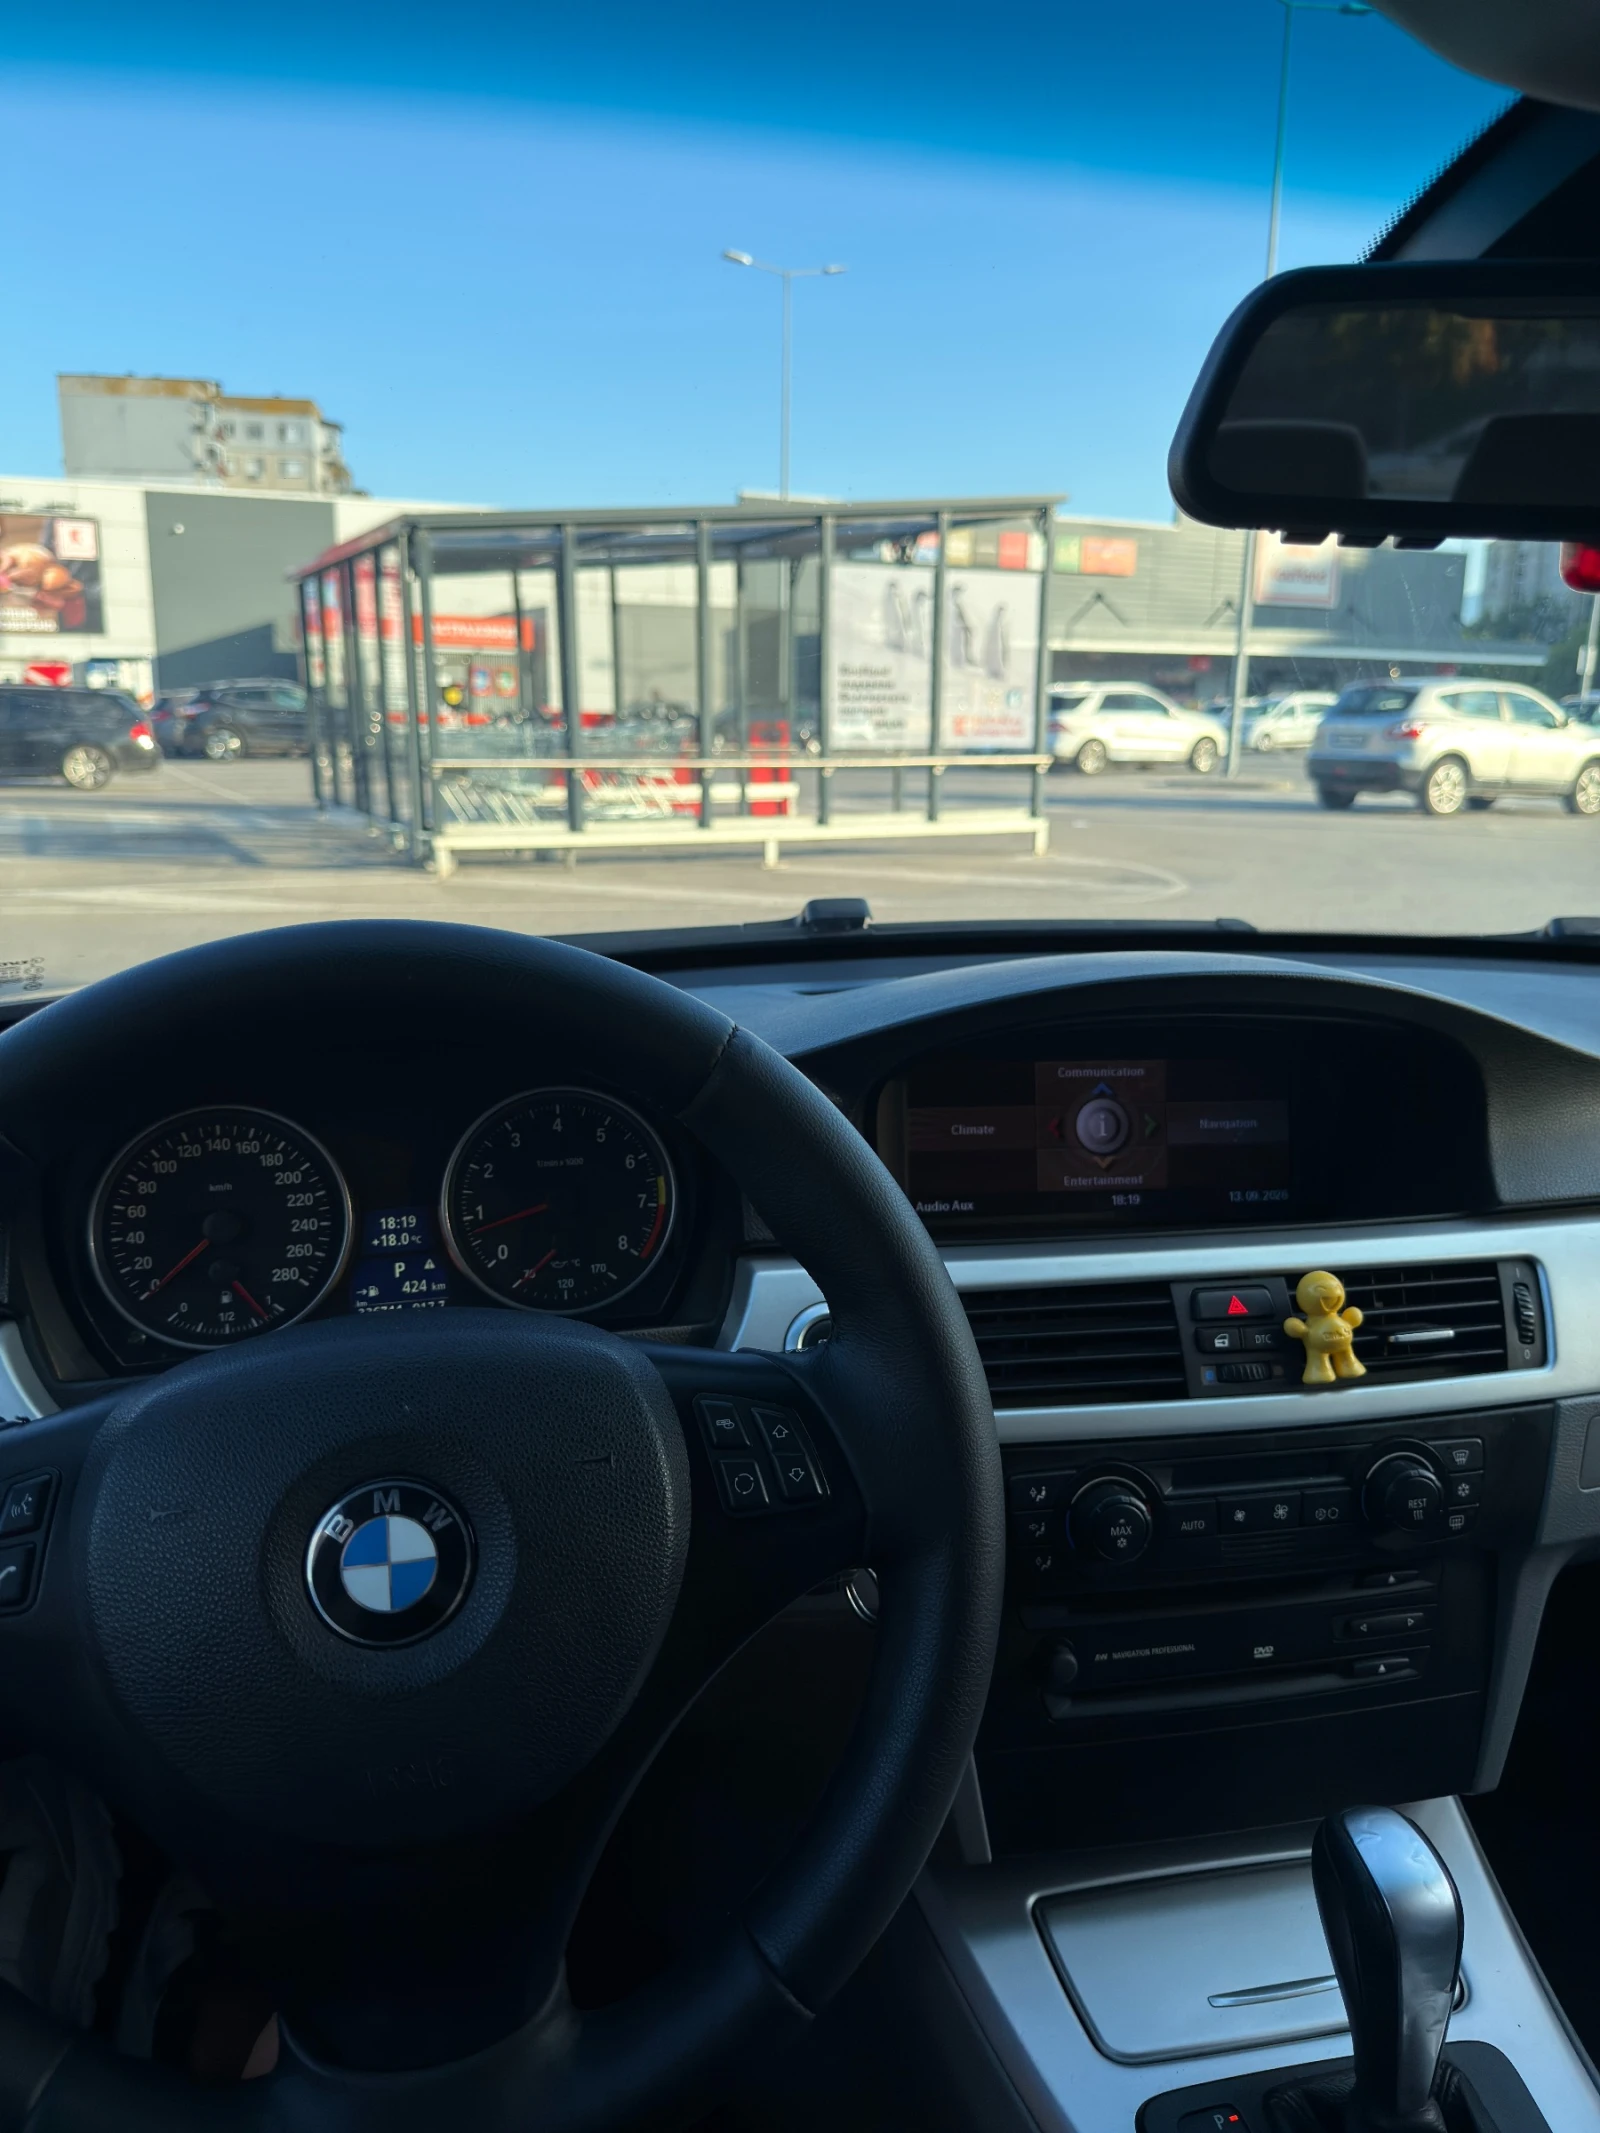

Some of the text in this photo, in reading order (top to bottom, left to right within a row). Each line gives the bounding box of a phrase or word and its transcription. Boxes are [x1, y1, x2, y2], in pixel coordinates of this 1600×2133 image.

[1057, 1067, 1145, 1078] Communication
[552, 1117, 564, 1133] 4
[950, 1124, 995, 1136] Climate
[1199, 1119, 1258, 1131] Navigation
[510, 1132, 521, 1148] 3
[596, 1127, 606, 1143] 5
[177, 1143, 202, 1158] 120
[205, 1137, 231, 1152] 140
[235, 1140, 260, 1155] 160
[151, 1160, 178, 1174] 100
[259, 1153, 284, 1167] 180
[625, 1154, 636, 1169] 6
[483, 1163, 494, 1178] 2
[274, 1171, 302, 1186] 200
[1063, 1174, 1144, 1187] Entertainment
[137, 1181, 157, 1195] 80
[208, 1182, 233, 1192] km/h
[286, 1192, 314, 1208] 220
[637, 1193, 648, 1209] 7
[915, 1199, 974, 1213] Audio Aux
[1111, 1193, 1141, 1206] 18:19
[127, 1204, 147, 1219] 60
[475, 1204, 484, 1220] 1
[291, 1217, 319, 1233] 240
[379, 1215, 417, 1230] 18:19
[125, 1230, 145, 1245] 40
[371, 1232, 410, 1247] +18.0
[617, 1234, 629, 1251] 8
[286, 1242, 313, 1258] 260
[497, 1244, 509, 1260] 0
[133, 1255, 153, 1270] 20
[394, 1261, 406, 1279] P
[590, 1262, 607, 1275] 170
[271, 1266, 300, 1283] 280
[401, 1279, 447, 1294] 424 km
[557, 1278, 575, 1289] 120
[179, 1302, 189, 1313] 0
[218, 1311, 236, 1322] 1/2
[1254, 1333, 1272, 1344] DTC
[1408, 1497, 1428, 1509] REST
[323, 1488, 454, 1545] BMW
[1110, 1525, 1133, 1536] MAX
[1180, 1519, 1206, 1531] AUTO
[1151, 1643, 1196, 1655] PROFESSIONAL
[1253, 1645, 1275, 1657] DVD
[1213, 2114, 1225, 2131] P
